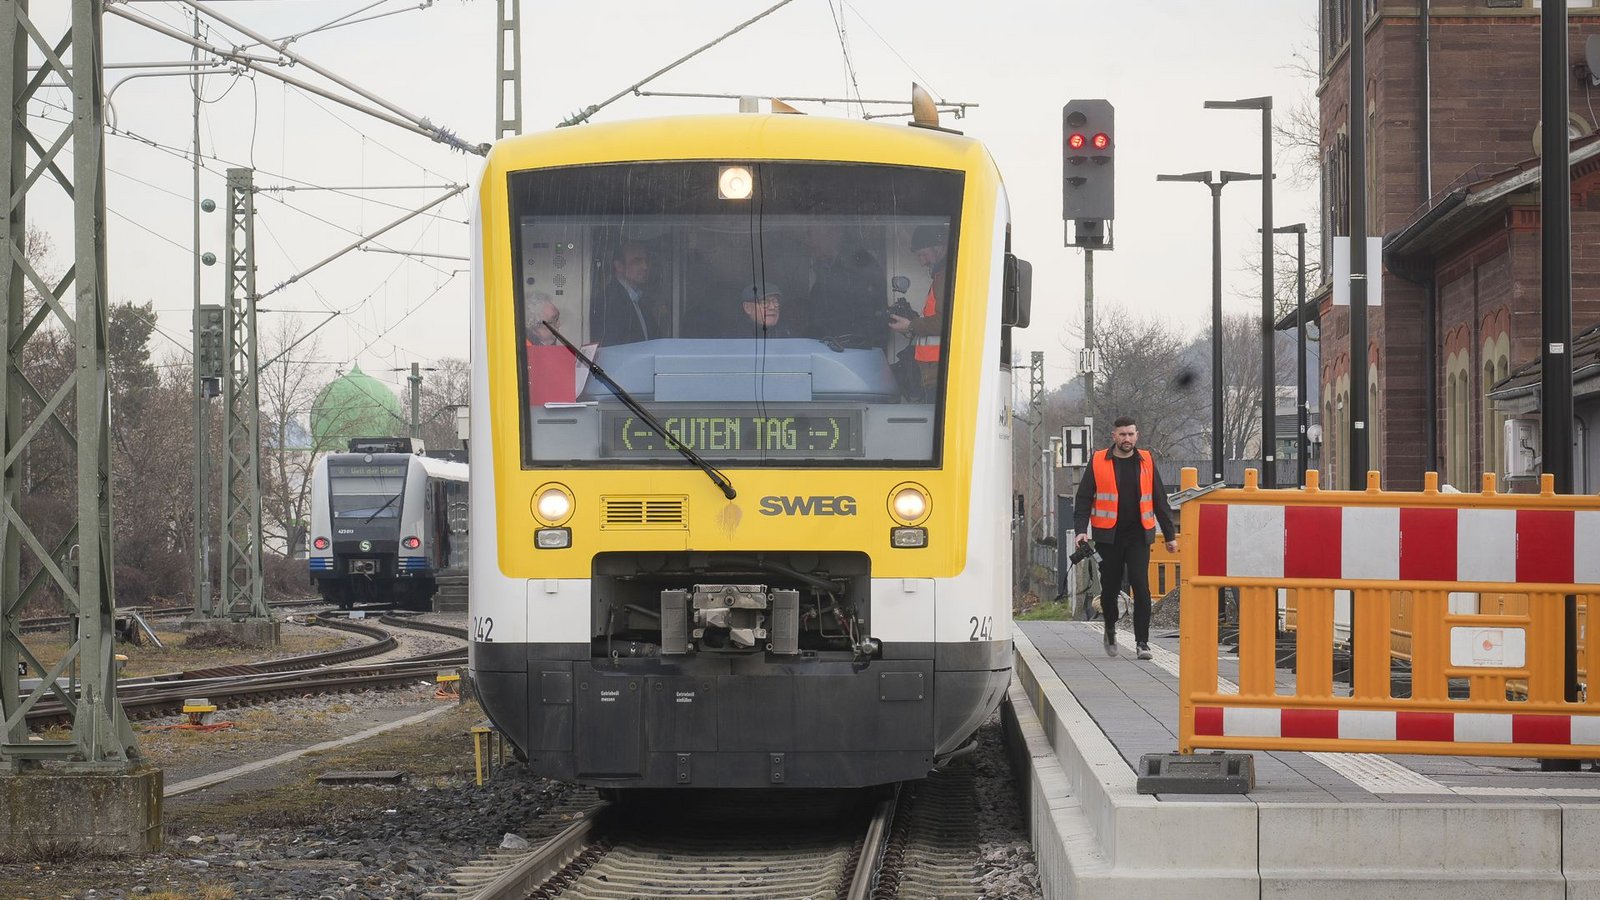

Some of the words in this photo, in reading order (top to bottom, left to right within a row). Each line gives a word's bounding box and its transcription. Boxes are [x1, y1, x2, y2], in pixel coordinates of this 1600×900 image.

[665, 417, 741, 450] GUTEN
[753, 417, 797, 450] TAG
[1065, 429, 1088, 464] H
[759, 496, 857, 516] SWEG
[969, 616, 993, 641] 242
